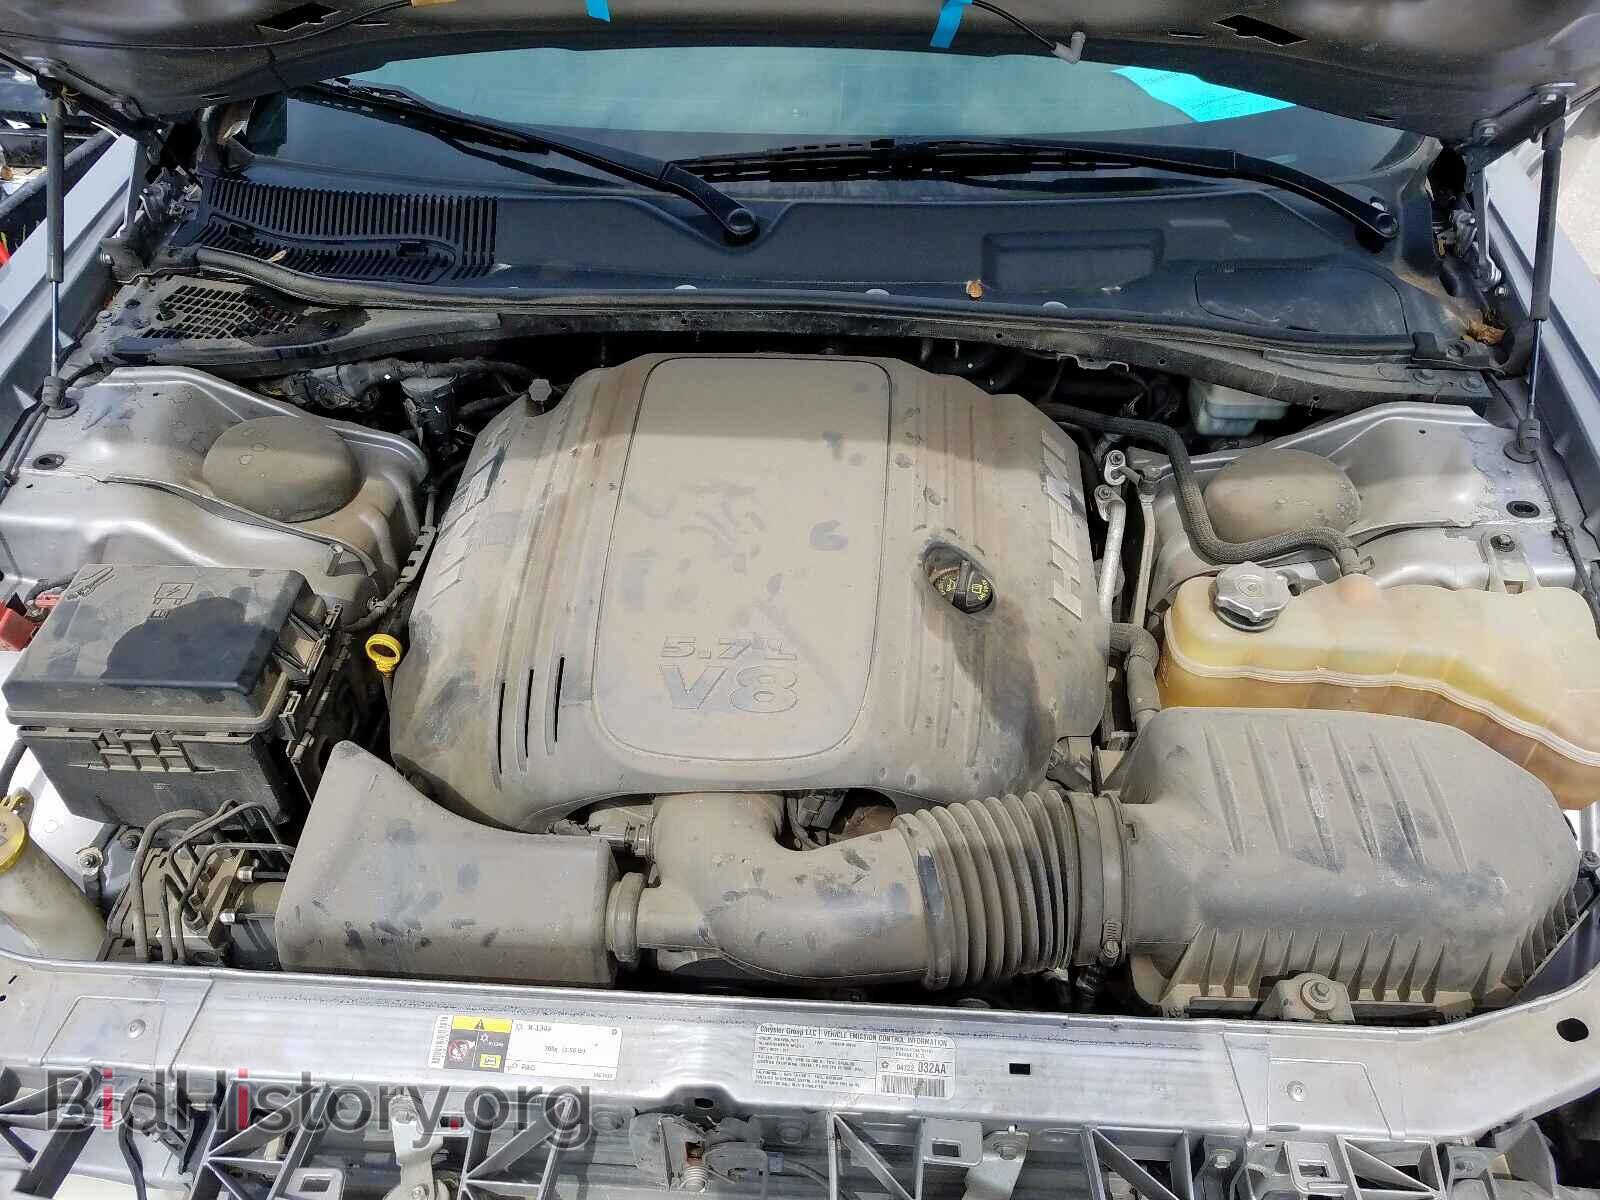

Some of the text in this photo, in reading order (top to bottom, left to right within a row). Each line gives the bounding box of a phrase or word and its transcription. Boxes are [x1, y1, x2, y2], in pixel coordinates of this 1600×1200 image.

[658, 664, 798, 713] V8
[760, 1025, 948, 1047] Chrysler Group LLC VEHICLE EMISSION CONTROL INFORMATION
[918, 1062, 946, 1074] 032AA
